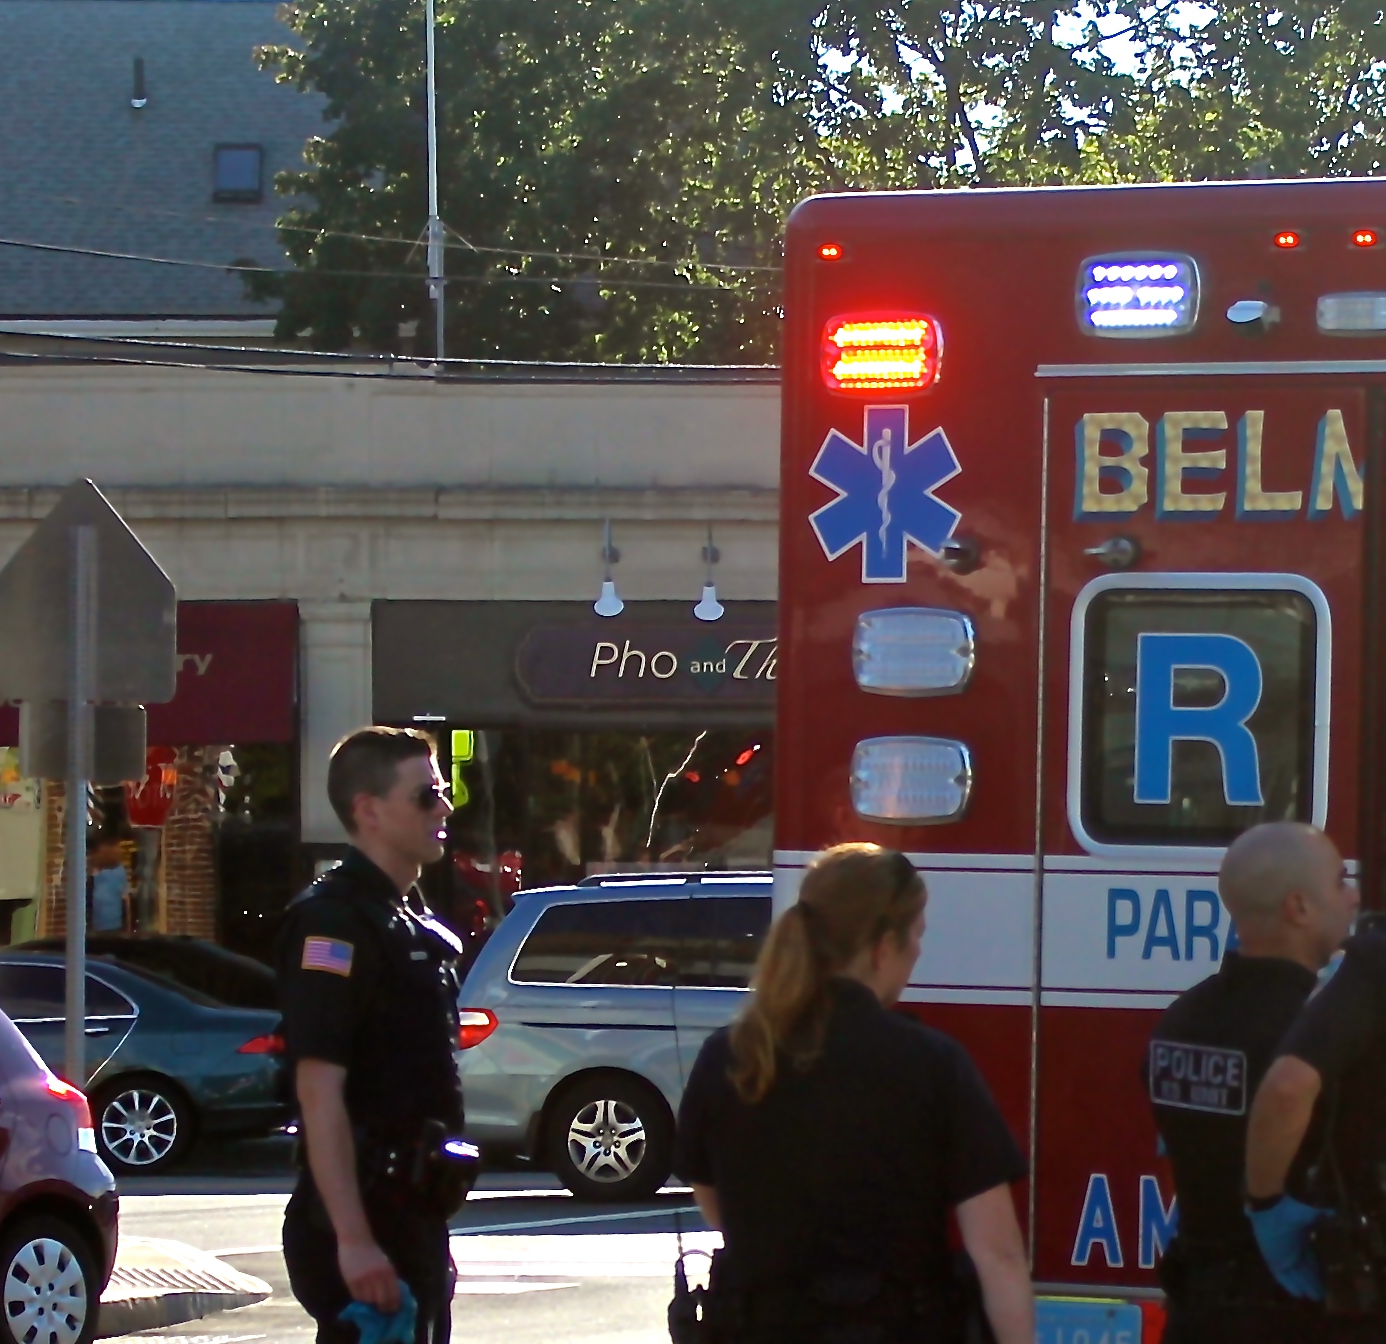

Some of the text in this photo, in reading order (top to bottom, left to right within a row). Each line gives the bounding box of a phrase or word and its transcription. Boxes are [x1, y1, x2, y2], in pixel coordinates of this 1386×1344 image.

[589, 639, 678, 679] Pho
[690, 658, 726, 673] and
[1156, 1046, 1241, 1087] POLICE
